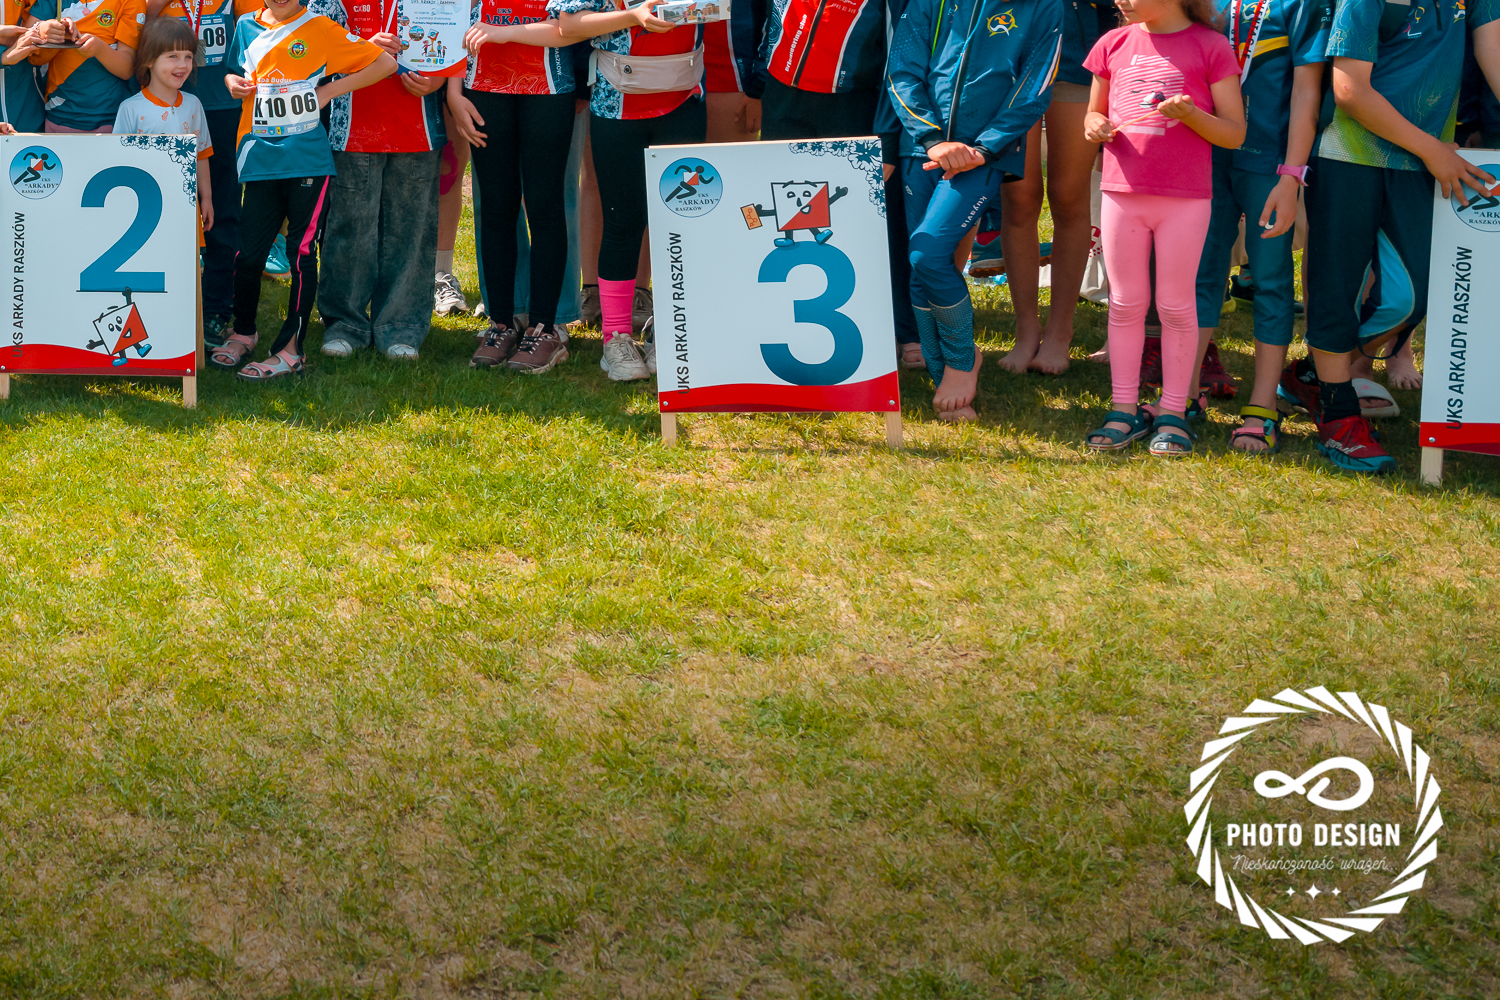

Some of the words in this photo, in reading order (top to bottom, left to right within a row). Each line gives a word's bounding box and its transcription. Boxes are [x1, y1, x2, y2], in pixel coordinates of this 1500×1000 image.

[203, 27, 226, 47] 08
[255, 98, 263, 117] K
[265, 97, 286, 118] 10
[291, 92, 317, 115] 06
[12, 212, 25, 274] RASZKÓW
[79, 165, 166, 291] 2
[667, 232, 685, 302] RASZKÓW
[1453, 246, 1473, 329] RASZKÓW
[13, 276, 24, 328] ARKADY
[757, 241, 864, 386] 3
[12, 330, 23, 357] UKS
[672, 303, 690, 363] ARKADY
[1449, 330, 1468, 395] ARKADY
[677, 365, 691, 394] UKS
[1446, 397, 1463, 430] UKS
